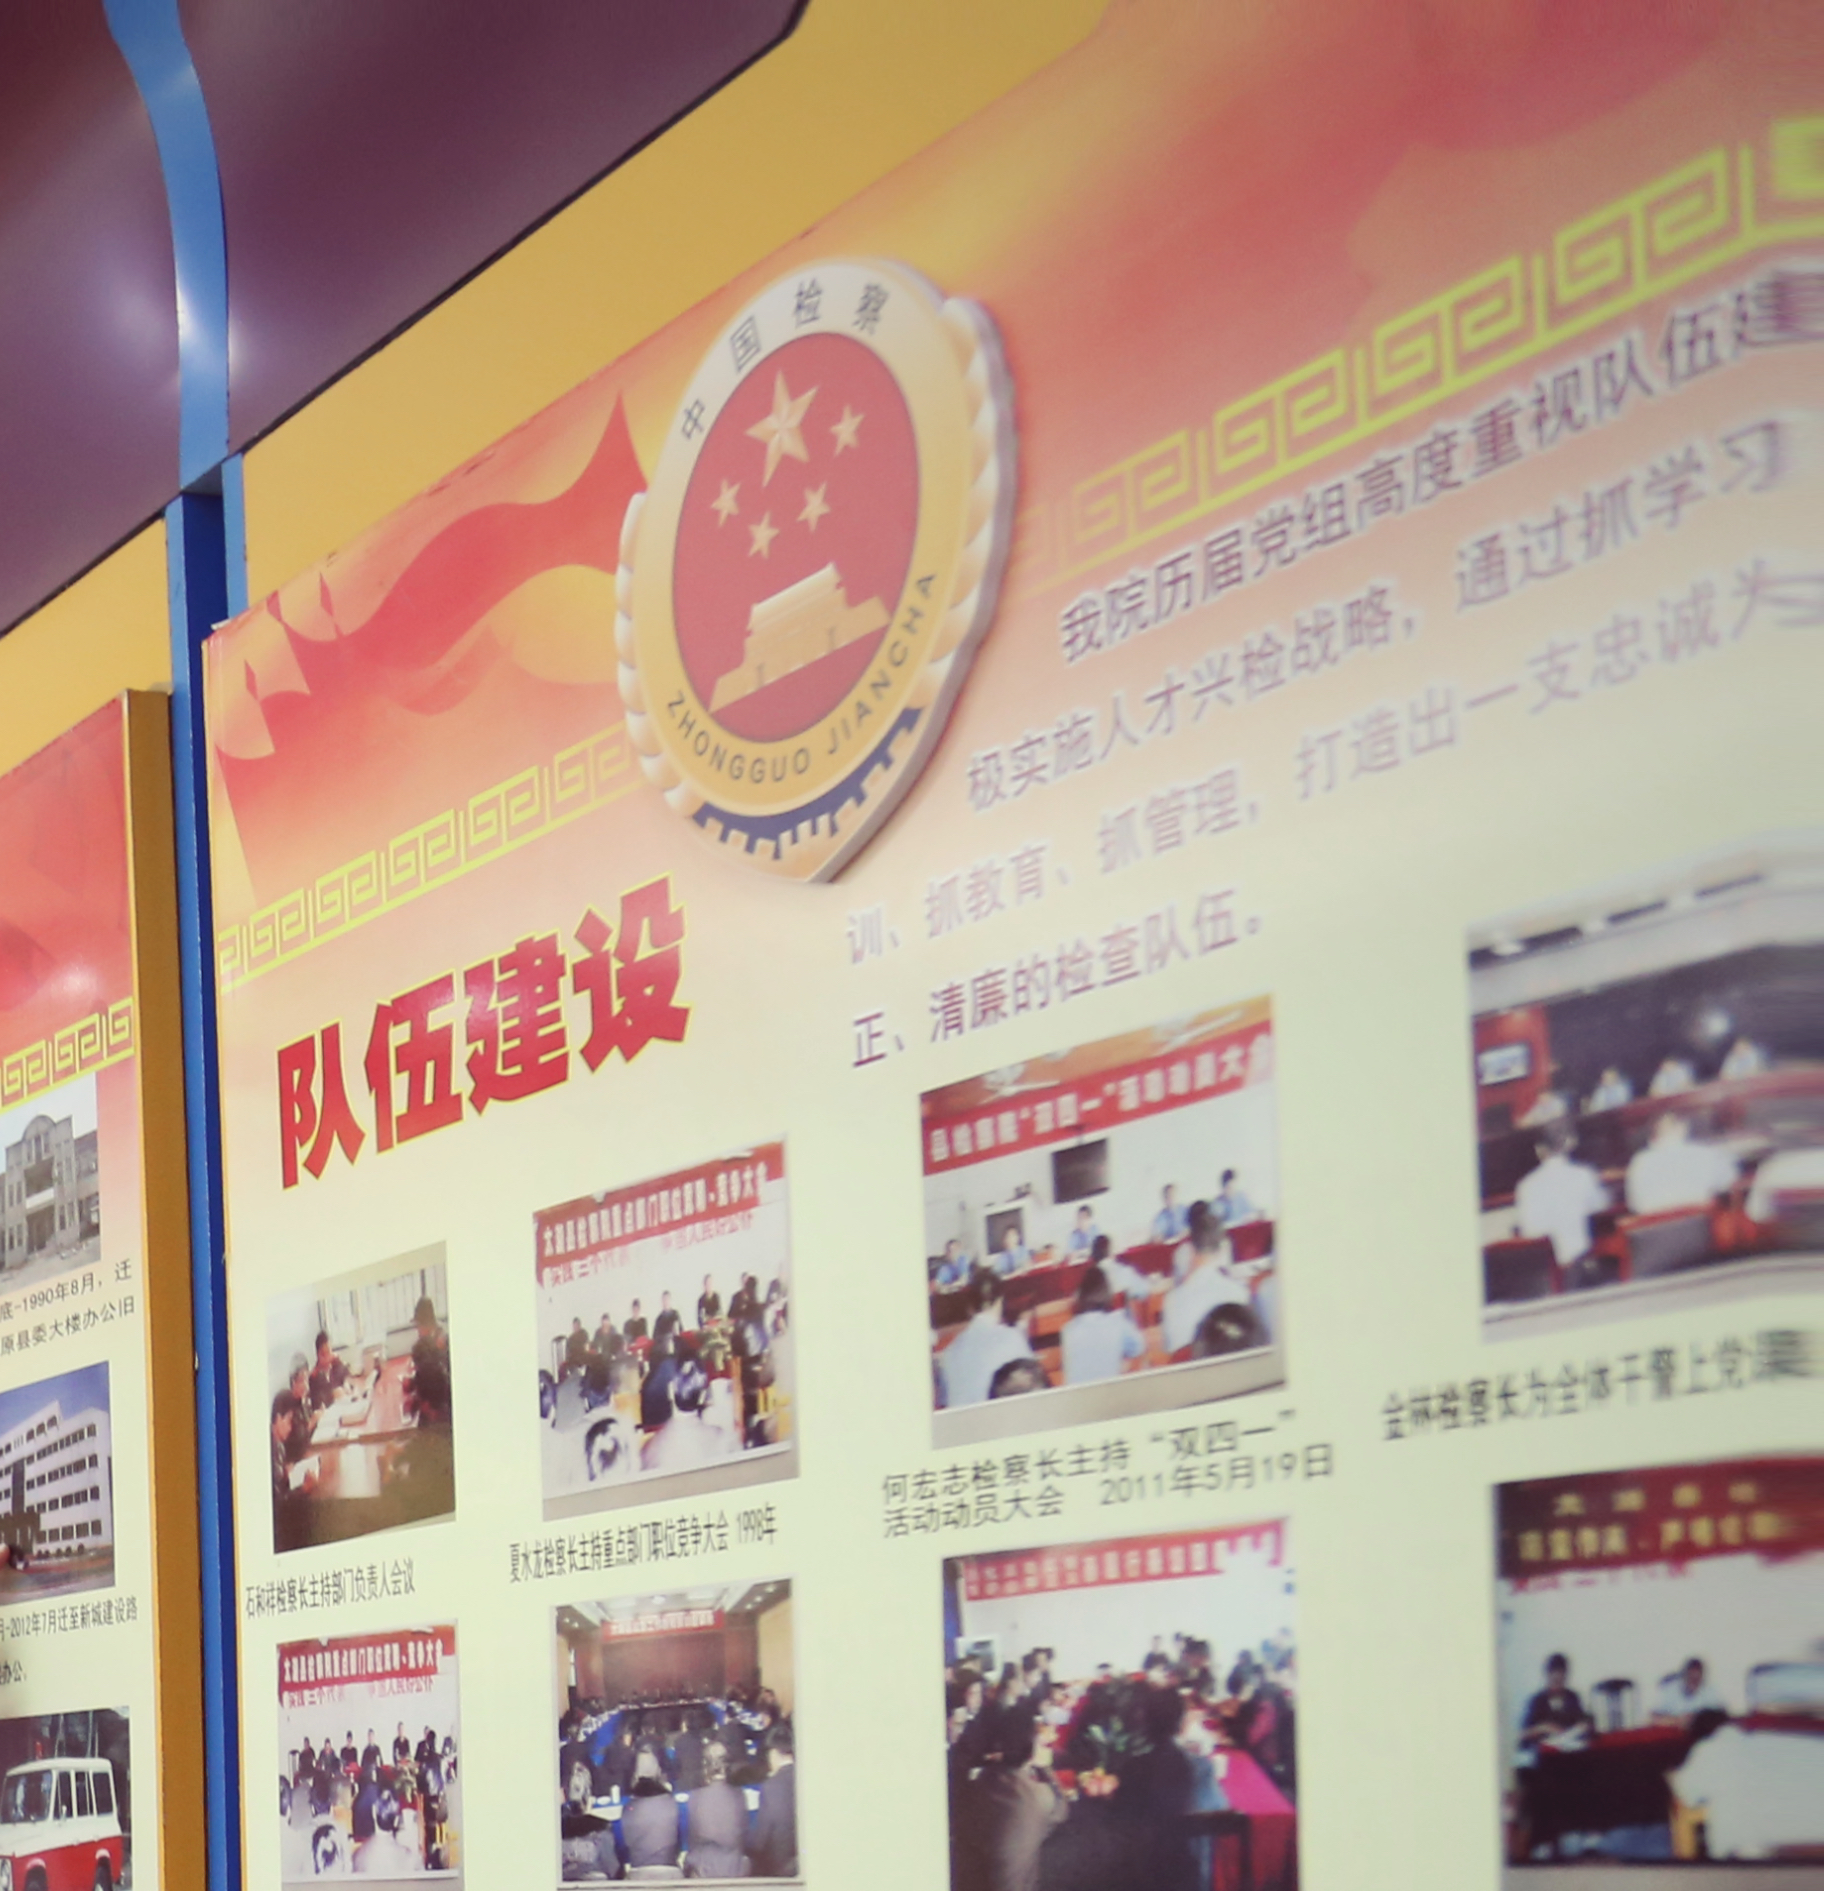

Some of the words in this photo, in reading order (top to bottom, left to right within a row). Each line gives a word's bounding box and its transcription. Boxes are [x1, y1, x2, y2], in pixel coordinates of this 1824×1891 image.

[665, 689, 812, 787] ZHONGGUO
[825, 572, 935, 758] JIANCHA
[276, 873, 691, 1192] 队伍建设
[883, 1485, 1065, 1539] 活动动员大会
